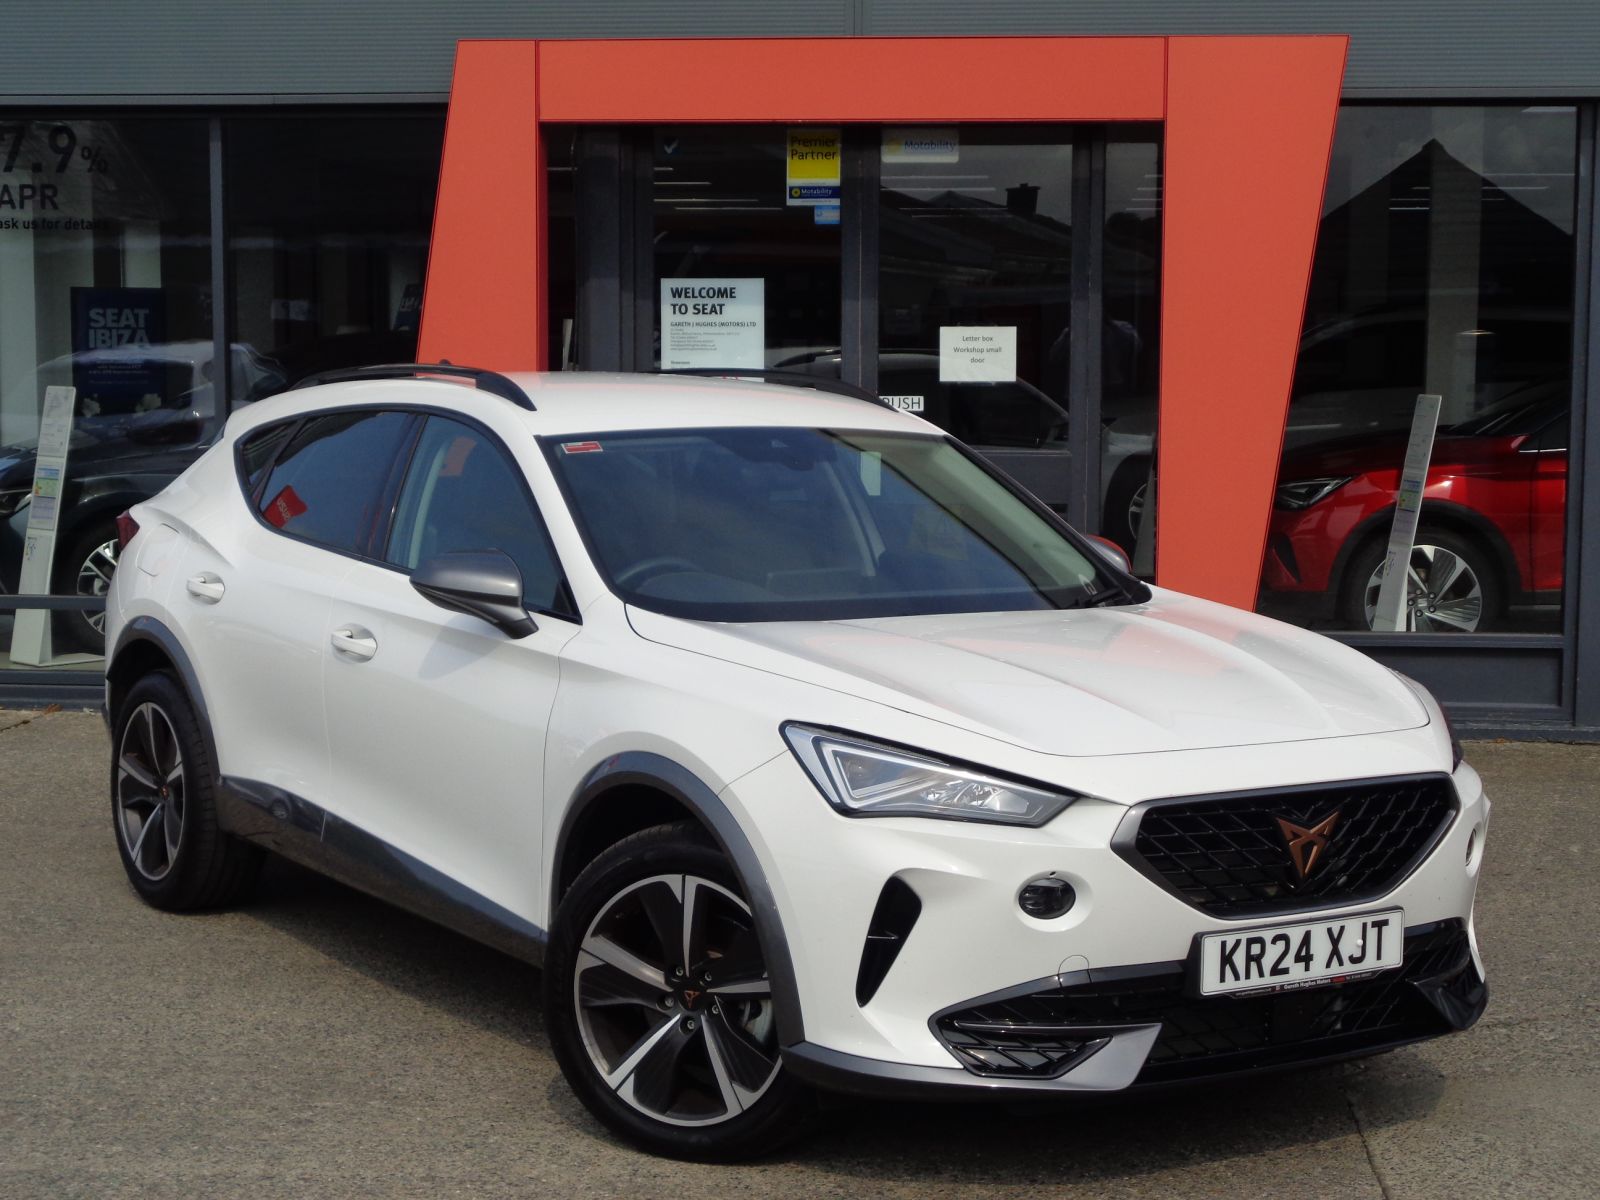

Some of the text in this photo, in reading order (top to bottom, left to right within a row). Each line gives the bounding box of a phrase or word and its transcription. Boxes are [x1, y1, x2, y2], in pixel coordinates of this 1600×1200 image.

[790, 135, 837, 148] Premier
[904, 138, 956, 153] Motability
[790, 149, 837, 161] Partner
[0, 184, 58, 210] APR
[801, 188, 832, 196] Motability
[23, 220, 37, 230] us
[42, 217, 59, 230] for
[670, 287, 737, 299] WELCOME
[670, 303, 725, 315] TO SEAT
[88, 307, 150, 328] SEAT
[718, 321, 746, 329] (MOTORS)
[88, 328, 150, 350] IBIZA
[953, 346, 984, 354] Workshop
[1219, 918, 1390, 984] KR24 XJT
